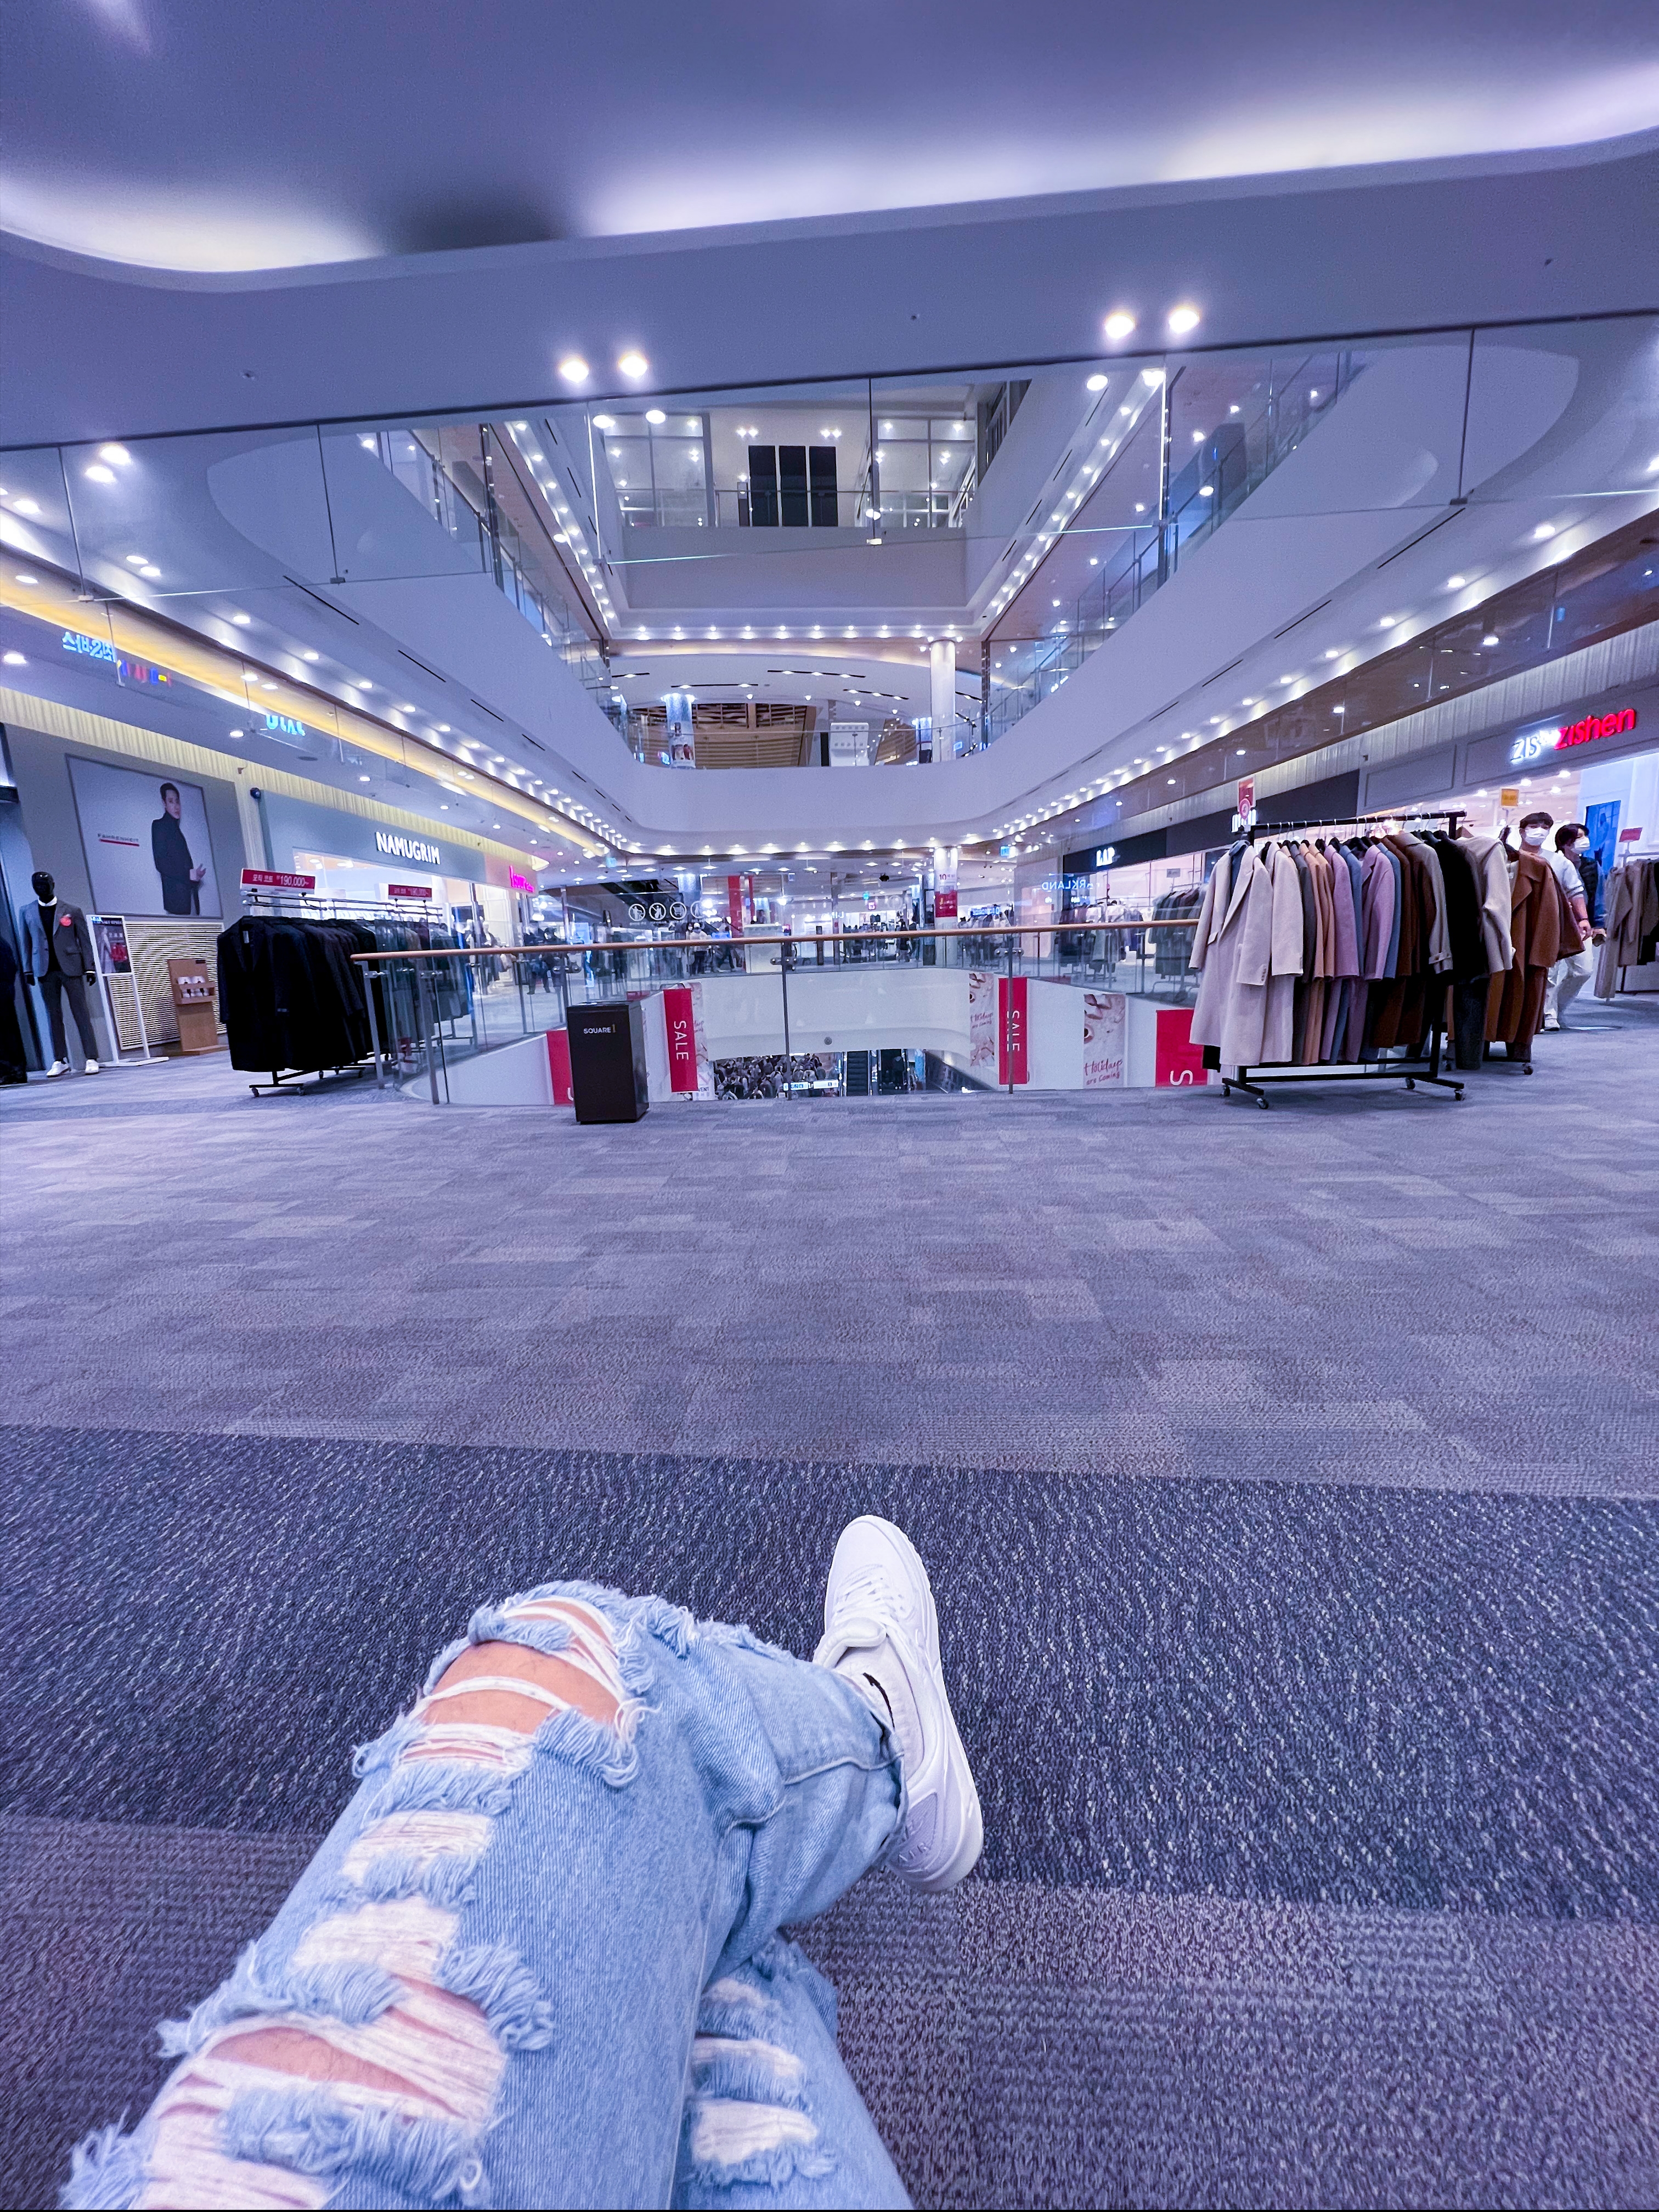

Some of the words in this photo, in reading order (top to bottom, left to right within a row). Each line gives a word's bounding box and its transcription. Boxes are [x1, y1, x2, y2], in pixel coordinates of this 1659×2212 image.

[375, 831, 441, 865] NAMUGRIM
[674, 1020, 689, 1060] SALE
[1007, 1010, 1020, 1052] SALE
[1084, 1058, 1123, 1076] Holidays
